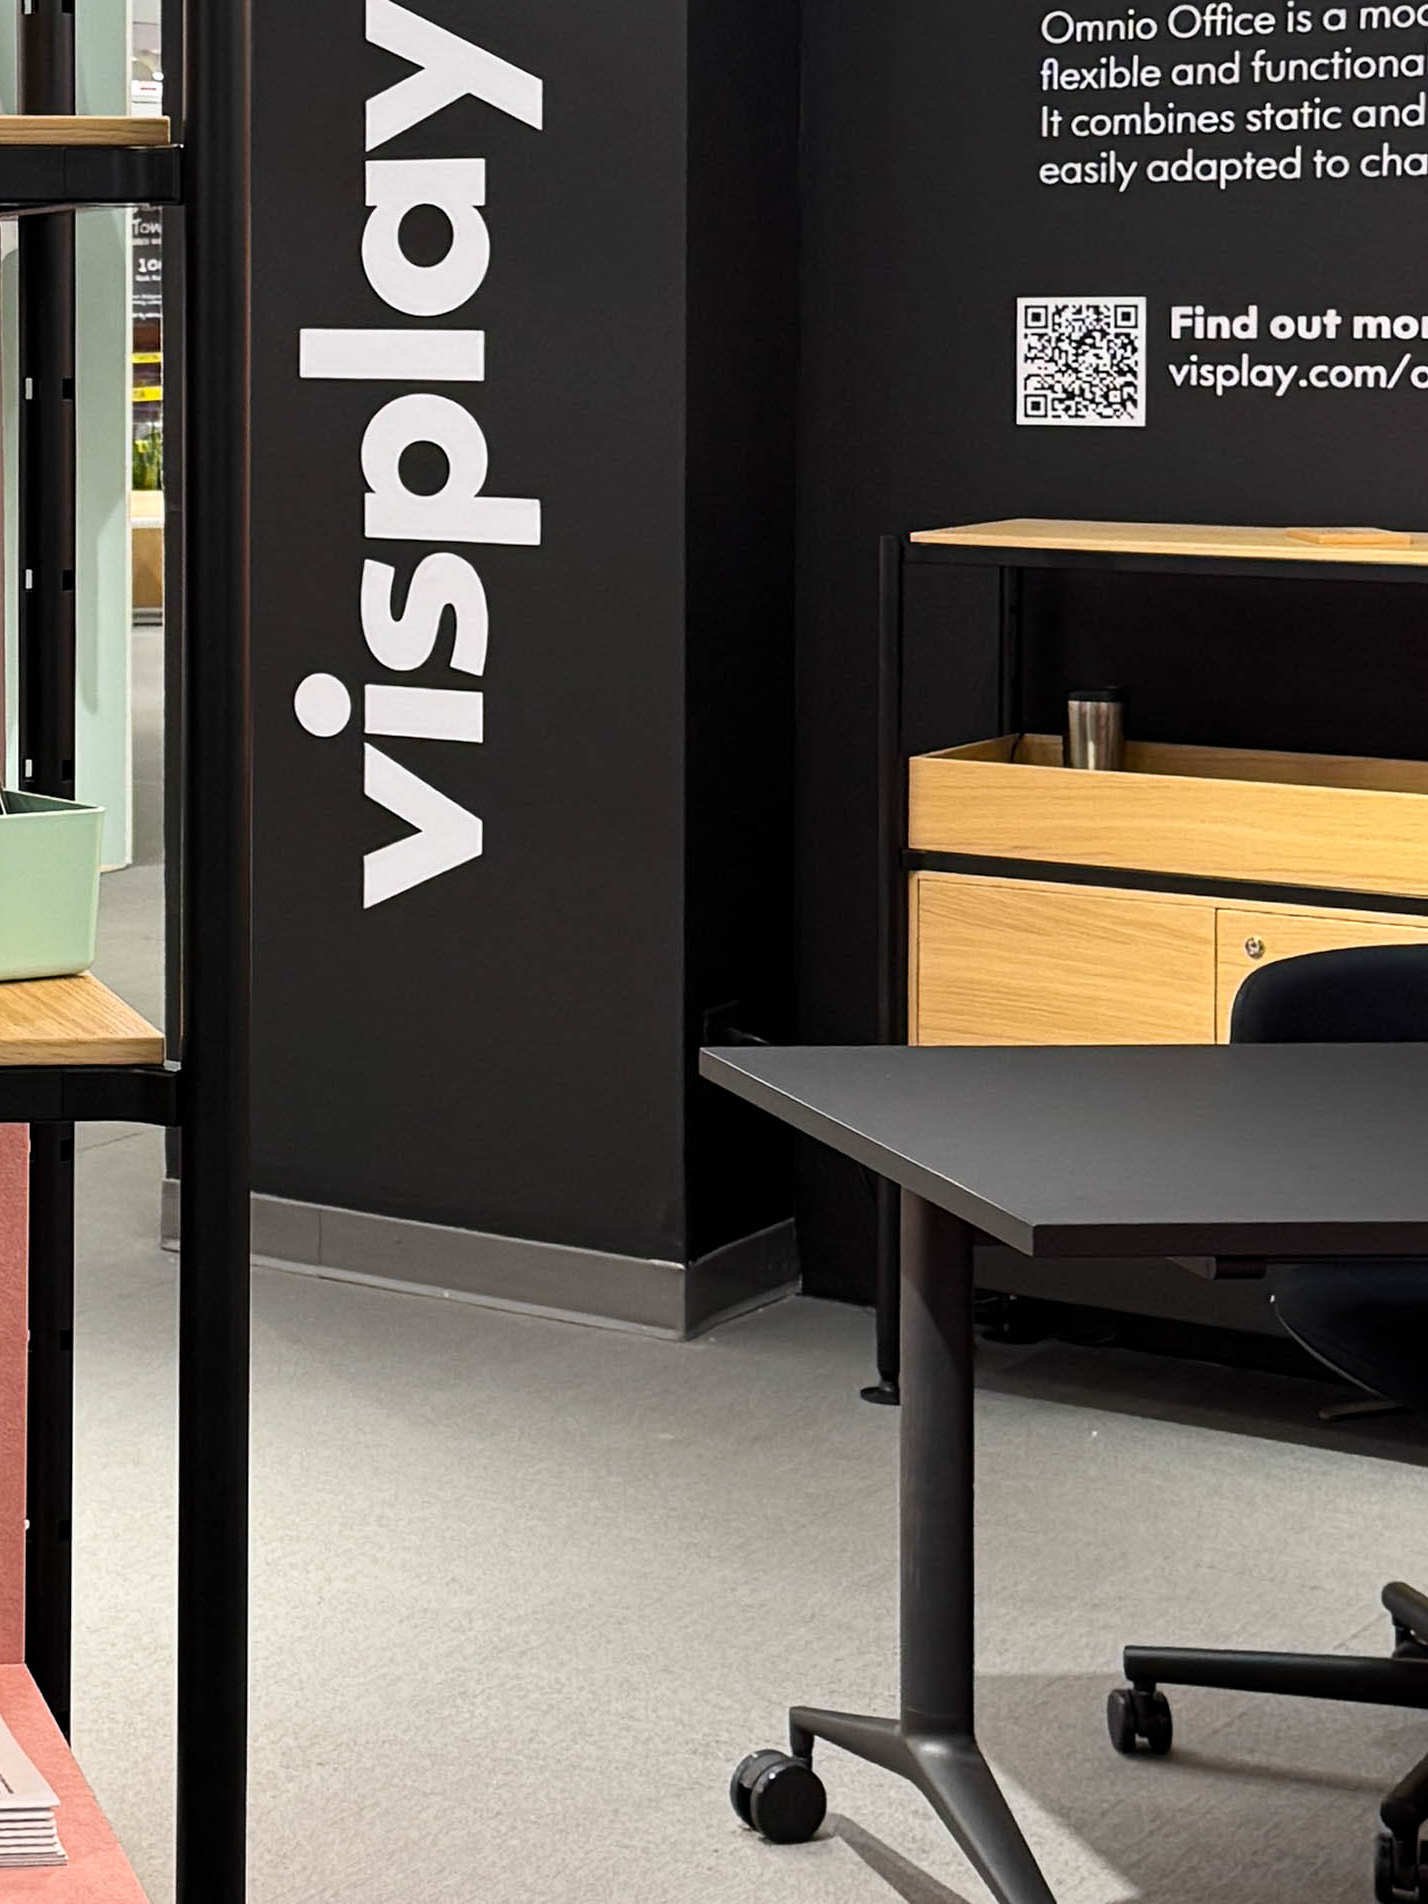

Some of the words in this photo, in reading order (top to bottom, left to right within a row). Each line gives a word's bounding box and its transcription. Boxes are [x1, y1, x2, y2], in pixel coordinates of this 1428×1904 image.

[1041, 8, 1158, 44] Omnio
[1168, 2, 1276, 39] Office
[1287, 0, 1313, 33] is
[1322, 7, 1347, 32] a
[1040, 54, 1162, 91] flexible
[1171, 49, 1241, 86] and
[1041, 105, 1063, 138] It
[1070, 101, 1236, 137] combines
[1245, 96, 1342, 132] static
[1352, 91, 1426, 127] and
[1039, 149, 1138, 193] easily
[1146, 144, 1302, 190] adapted
[1313, 148, 1350, 179] to
[1170, 304, 1258, 340] Find
[1269, 308, 1342, 340] out
